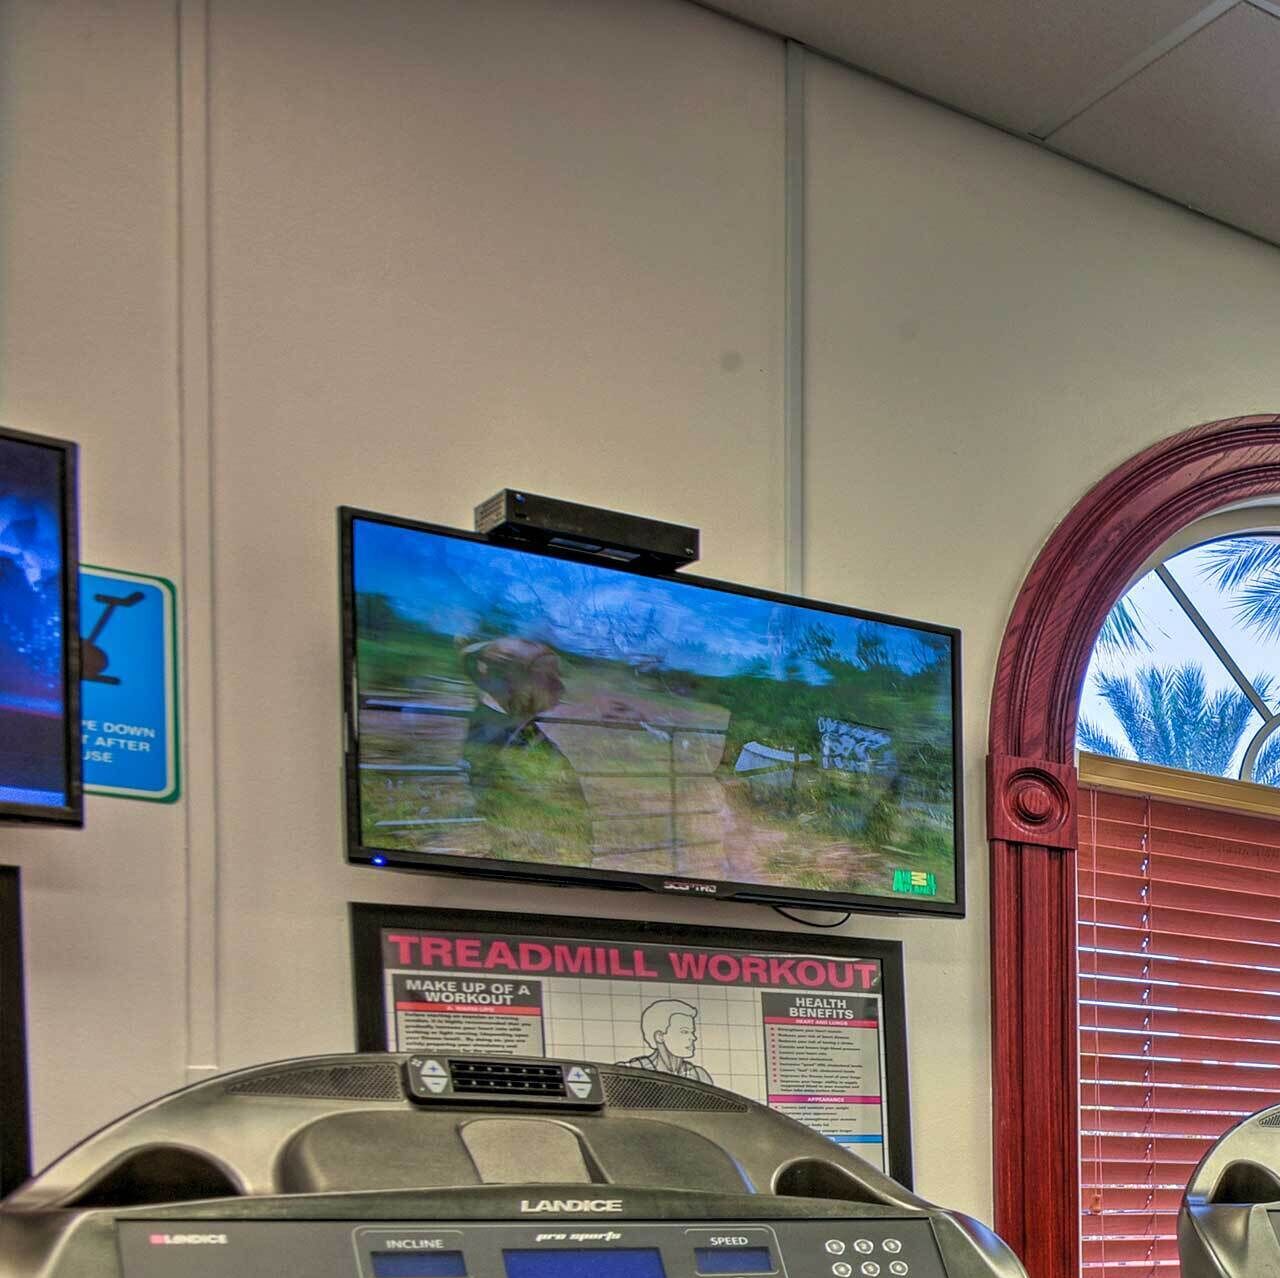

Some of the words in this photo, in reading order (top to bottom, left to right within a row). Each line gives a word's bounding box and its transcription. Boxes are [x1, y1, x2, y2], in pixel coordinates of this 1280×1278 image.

[103, 721, 156, 738] DOWN
[95, 736, 151, 752] AFTER
[388, 933, 658, 978] TREADMILL
[668, 951, 877, 990] WORKOUT
[405, 979, 457, 992] MAKE
[462, 981, 486, 993] UP
[491, 983, 514, 995] OF
[518, 985, 531, 996] A
[425, 992, 514, 1006] WORKOUT
[796, 997, 847, 1009] HEALTH
[789, 1007, 854, 1020] BENEFITS
[520, 1199, 624, 1213] LANDICE
[163, 1234, 229, 1245] LANDICE
[535, 1232, 567, 1242] pro
[569, 1231, 622, 1242] sports
[709, 1236, 749, 1247] SPEED
[385, 1239, 445, 1249] INCLINE
